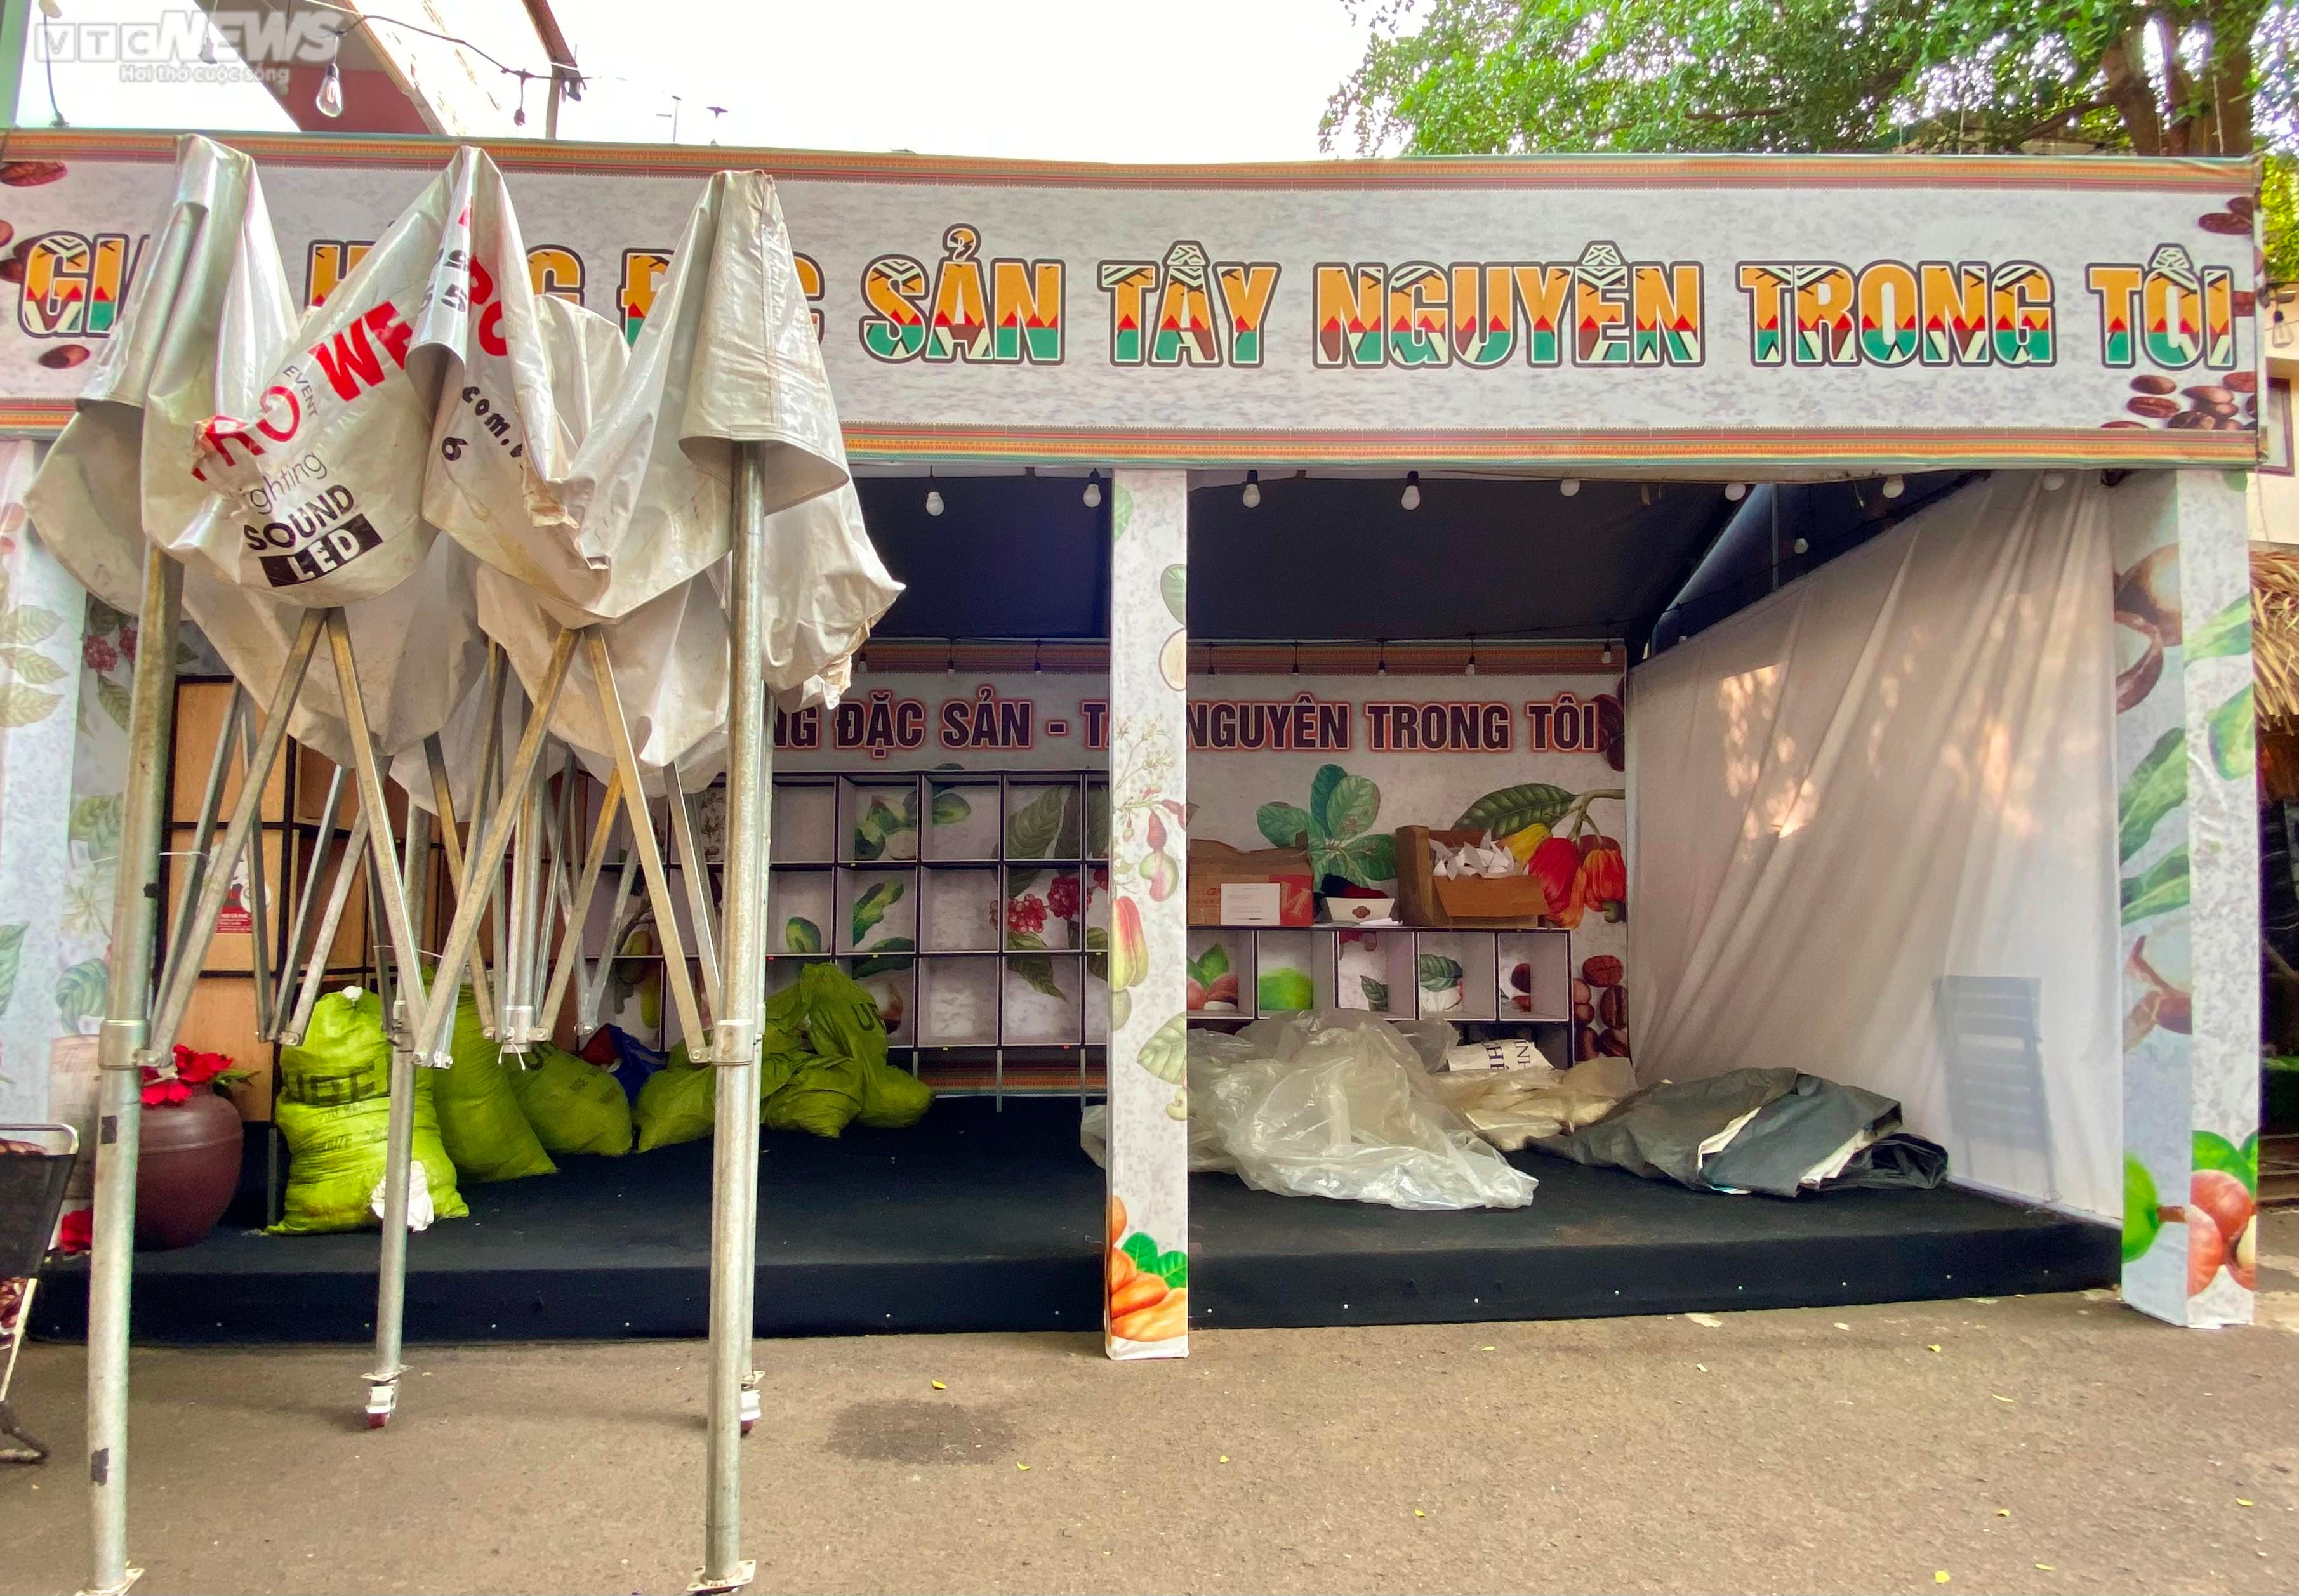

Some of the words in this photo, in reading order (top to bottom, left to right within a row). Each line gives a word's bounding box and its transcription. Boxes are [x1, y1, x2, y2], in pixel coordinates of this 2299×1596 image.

[859, 223, 1066, 366] SẢN
[1097, 241, 1281, 368] TÂY
[1313, 241, 1706, 369] NGUYÊN
[1736, 260, 2057, 368] TRONG
[2086, 243, 2237, 370] TÔI
[283, 366, 318, 417] EVENT
[244, 484, 354, 550] SOUND
[286, 528, 360, 581] LED
[835, 690, 925, 759] ĐẶC
[942, 685, 1033, 749] SẢN
[1186, 693, 1350, 750] NGUYÊN
[1364, 702, 1511, 751] TRONG
[1525, 693, 1600, 752] TÔI
